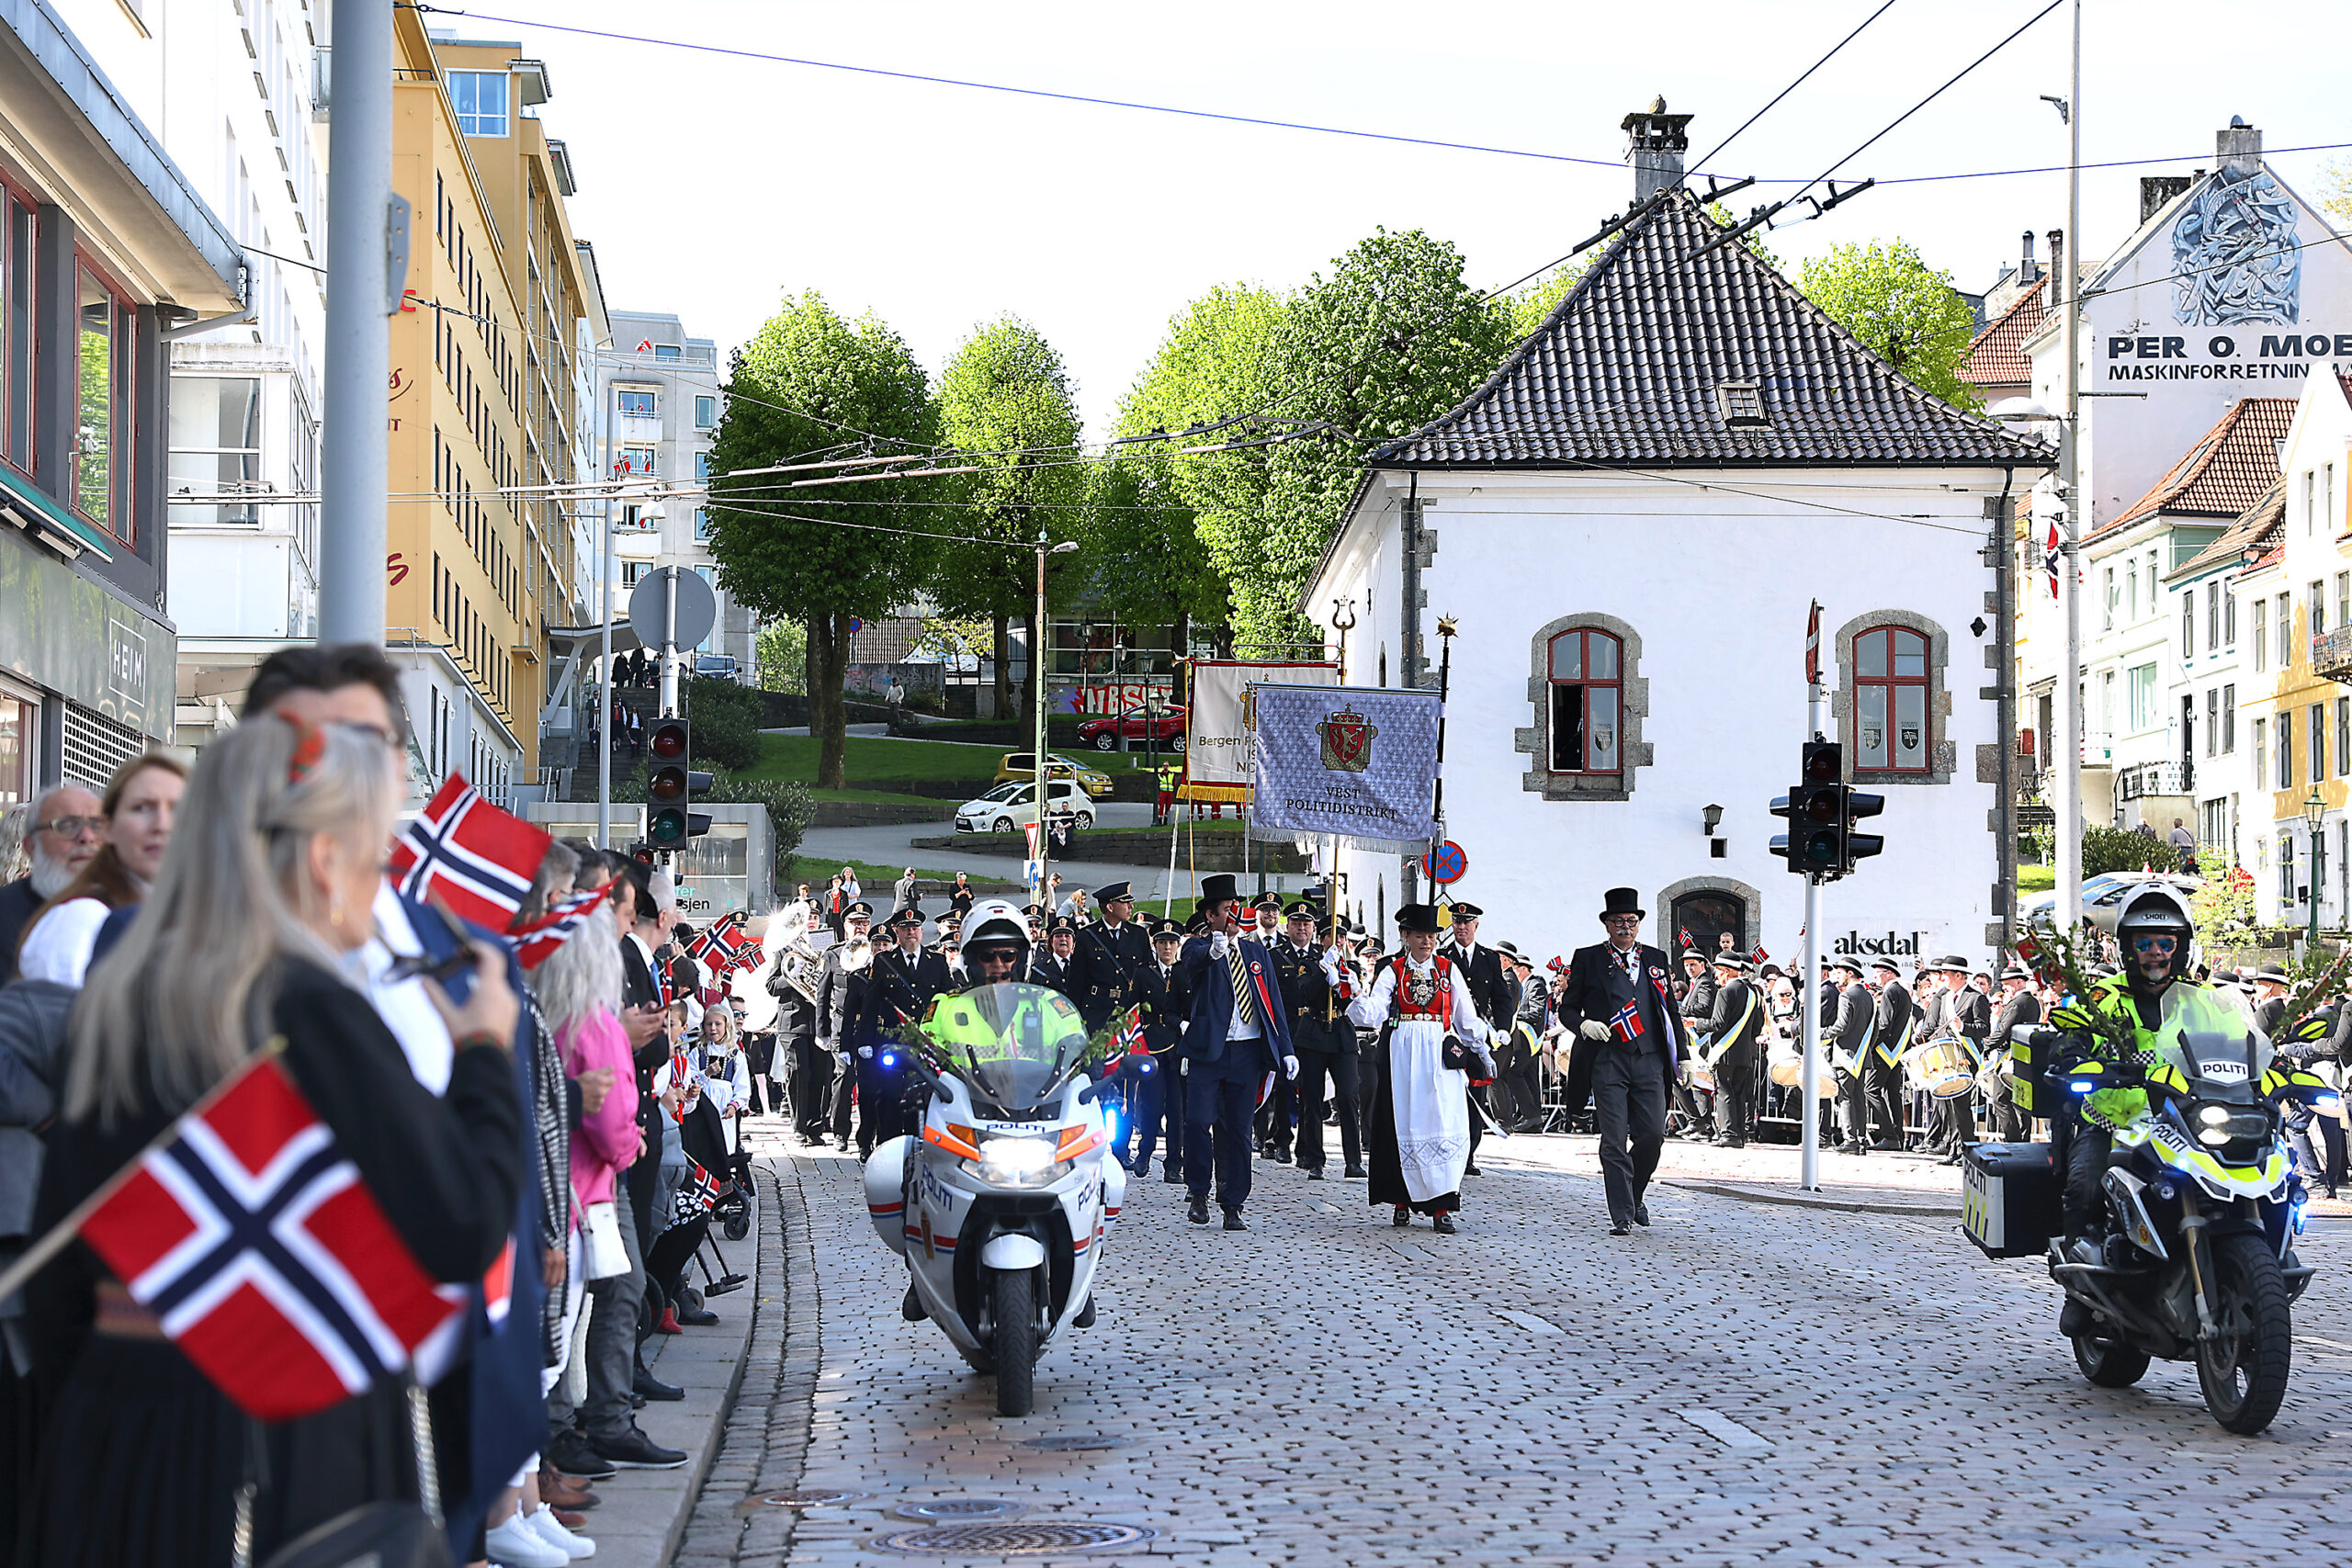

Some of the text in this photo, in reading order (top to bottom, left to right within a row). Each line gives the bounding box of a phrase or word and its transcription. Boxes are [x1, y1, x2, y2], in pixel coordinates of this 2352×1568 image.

[2109, 334, 2352, 359] PER O. MOE
[2109, 364, 2310, 380] MASKINFORRETNIN
[114, 639, 142, 688] HEIM
[1199, 736, 1241, 748] Bergen
[1325, 786, 1360, 799] VEST
[1285, 798, 1397, 819] POLITIDISTRIKT
[1834, 930, 1919, 955] aksdal
[2203, 1064, 2246, 1075] POLITI
[986, 1122, 1046, 1134] POLITI
[2153, 1125, 2188, 1153] POLITI
[922, 1163, 953, 1212] POLITI
[1964, 1158, 1986, 1196] POLITI
